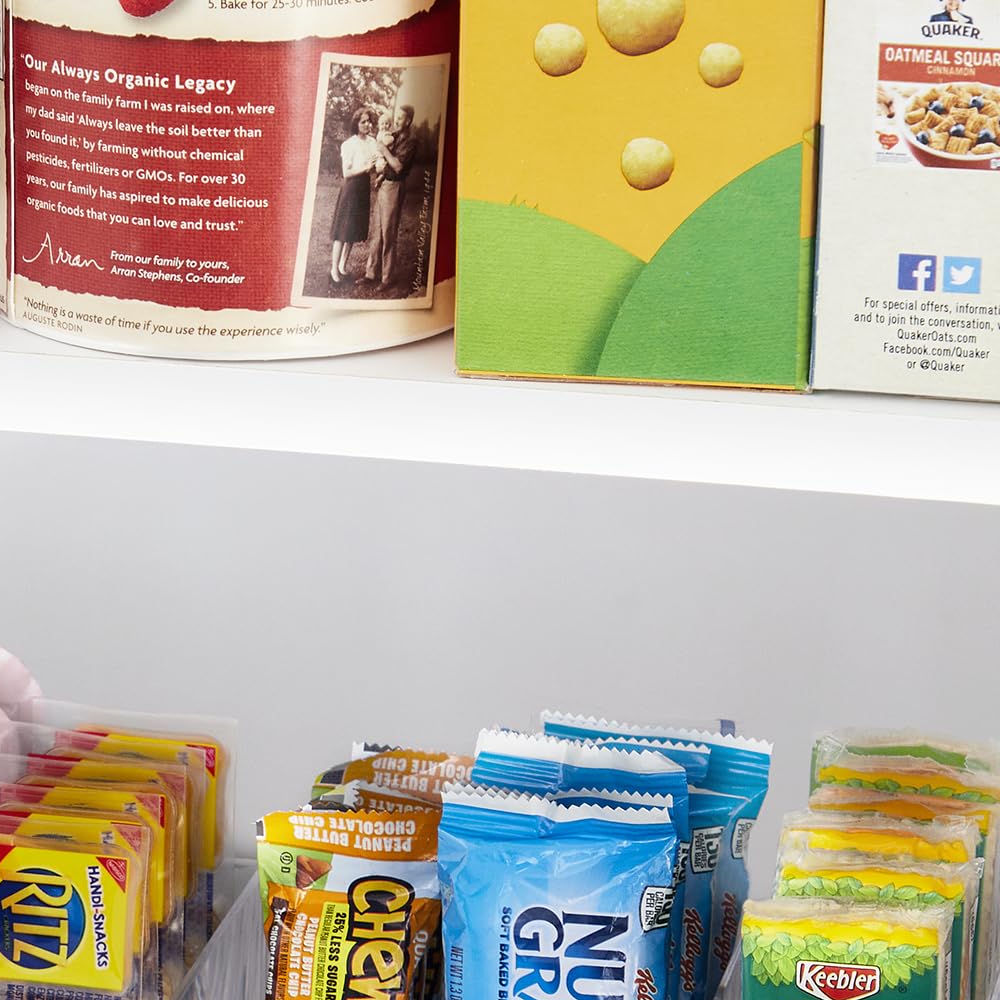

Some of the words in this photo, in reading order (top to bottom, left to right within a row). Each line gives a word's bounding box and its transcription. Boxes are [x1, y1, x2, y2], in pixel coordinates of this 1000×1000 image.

[921, 23, 980, 39] QUAKER
[885, 47, 951, 65] OATMEAL
[51, 60, 100, 83] Always
[104, 69, 169, 89] Organic
[175, 74, 236, 94] Legacy
[27, 172, 49, 189] years,
[50, 179, 66, 190] our
[67, 181, 97, 199] family
[100, 188, 117, 200] has
[119, 191, 160, 206] aspired
[162, 194, 175, 206] to
[179, 196, 210, 208] make
[214, 197, 268, 208] delicious
[110, 250, 134, 263] From
[135, 254, 152, 265] our
[152, 255, 184, 270] family
[185, 258, 197, 269] to
[198, 260, 230, 271] yours,
[110, 266, 136, 278] Arran
[137, 268, 184, 283] Stephens,
[185, 272, 245, 284] Co-founder
[864, 297, 879, 308] For
[882, 300, 917, 312] special
[920, 301, 952, 314] offers,
[854, 312, 872, 322] and
[875, 313, 885, 323] to
[887, 313, 906, 327] join
[909, 315, 925, 326] the
[928, 317, 994, 332] conversation,
[897, 328, 977, 343] QuakerOats.com
[883, 342, 990, 359] Facebook.com/Quaker
[907, 360, 916, 369] or
[919, 359, 965, 373] @Quaker
[289, 815, 325, 826] CHIP
[330, 817, 415, 836] CHOCOLATE
[294, 825, 348, 847] BUTTER
[355, 835, 412, 852] PEANUT
[0, 869, 73, 967] RITZ
[87, 865, 109, 969] HANDI-SNACKS
[334, 912, 347, 933] 25%
[501, 906, 512, 938] SOFT
[331, 935, 344, 960] LESS
[498, 943, 510, 986] BAKED
[800, 965, 878, 993] Keebler
